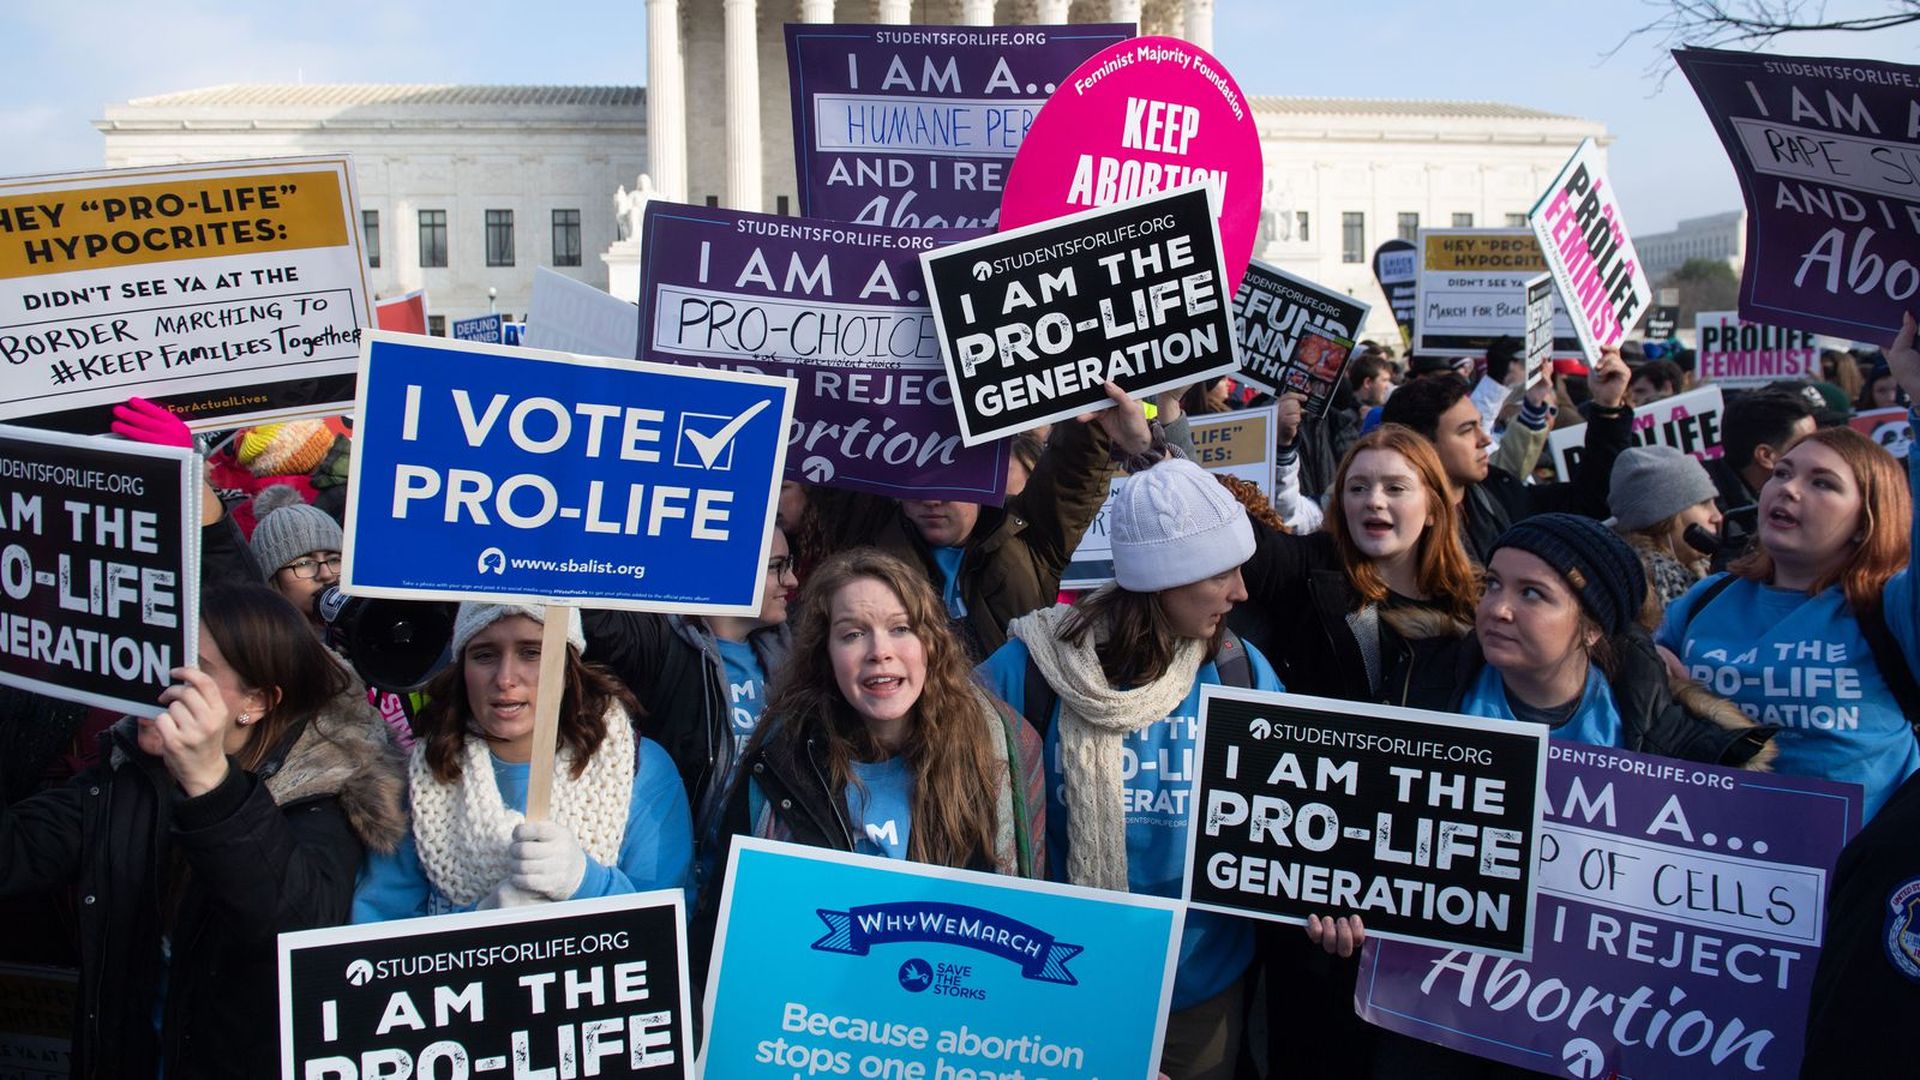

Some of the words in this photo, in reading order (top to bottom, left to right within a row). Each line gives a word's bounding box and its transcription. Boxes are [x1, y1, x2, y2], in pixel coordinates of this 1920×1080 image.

[876, 31, 1046, 46] STUDENTSFORLIFE.ORG
[847, 54, 859, 89] I
[881, 55, 962, 94] AM
[1074, 50, 1135, 96] Feminist
[1137, 45, 1192, 69] Majority
[1192, 55, 1244, 122] Foundation
[1764, 61, 1920, 88] STUDENTSFORLIFE.
[847, 105, 971, 147] HUMANE
[1122, 96, 1200, 155] KEEP
[1746, 81, 1769, 116] I
[1792, 85, 1881, 135] AM
[827, 158, 914, 189] AND
[930, 165, 937, 189] I
[954, 162, 1003, 191] RE
[1764, 129, 1851, 177] RAPE
[1776, 181, 1867, 222] AND
[1878, 200, 1896, 230] I
[25, 219, 287, 264] HYPOCRITES:
[737, 219, 934, 249] STUDENTSFORLIFE.ORG
[993, 214, 1176, 275] STUDENTSFORLIFE.ORG
[1443, 240, 1477, 252] HEY
[1565, 162, 1639, 330] PROLIFE
[699, 241, 711, 283] I
[735, 248, 833, 297] AM
[960, 294, 977, 324] I
[1001, 267, 1078, 315] AM
[1099, 234, 1195, 285] THE
[1448, 279, 1485, 287] DIDN'T
[1488, 279, 1507, 287] SEE
[1455, 255, 1548, 268] HYPOCRIT
[1544, 187, 1623, 345] FEMINIST
[23, 285, 112, 311] DIDN'T
[121, 277, 167, 298] SEE
[174, 277, 206, 292] YA
[215, 272, 243, 289] AT
[251, 266, 299, 284] THE
[0, 319, 138, 365] BORDER
[155, 303, 283, 337] MARCHING
[294, 298, 328, 317] TO
[456, 318, 498, 335] DEFUND
[458, 331, 499, 341] ANNED
[677, 298, 941, 360] PRO-CHOICE
[956, 269, 1219, 377] PRO-LIFE
[1703, 325, 1814, 353] PROLIFE
[974, 323, 1220, 417] GENERATION
[1701, 348, 1813, 376] FEMINIST
[160, 395, 268, 414] ForActualLives
[402, 384, 422, 441] I
[451, 389, 665, 463] VOTE
[1632, 413, 1656, 431] M
[1563, 410, 1719, 482] PLIFE
[391, 464, 735, 541] PRO-LIFE
[64, 500, 158, 554] THE
[0, 544, 177, 629] O-LIFE
[511, 556, 645, 579] www.sbalist.org
[1685, 640, 1695, 658] I
[1702, 647, 1758, 664] AM
[1774, 640, 1848, 663] THE
[1685, 665, 1862, 700] RO-LIFE
[1743, 704, 1859, 731] RATION
[1273, 723, 1492, 766] STUDENTSFORLIFE.ORG
[1225, 745, 1239, 779] I
[1267, 752, 1359, 795] AM
[1389, 766, 1506, 816] THE
[1205, 788, 1523, 880] PRO-LIFE
[1206, 852, 1510, 931] GENERATION
[1579, 848, 1640, 891] OF
[1654, 863, 1796, 924] CELLS
[377, 931, 630, 980] STUDENTSFORLIFE.ORG
[937, 962, 972, 976] SAVE
[1554, 906, 1566, 942] I
[1588, 911, 1800, 990] REJECT
[322, 1000, 338, 1041] I
[376, 982, 484, 1035] AM
[519, 960, 649, 1014] THE
[934, 985, 986, 1000] STORKS
[936, 974, 961, 986] THE
[1420, 949, 1775, 1072] Abortion
[756, 1037, 850, 1076] stops
[859, 1055, 926, 1080] one
[782, 1003, 929, 1049] Because
[937, 1025, 1084, 1069] abortion
